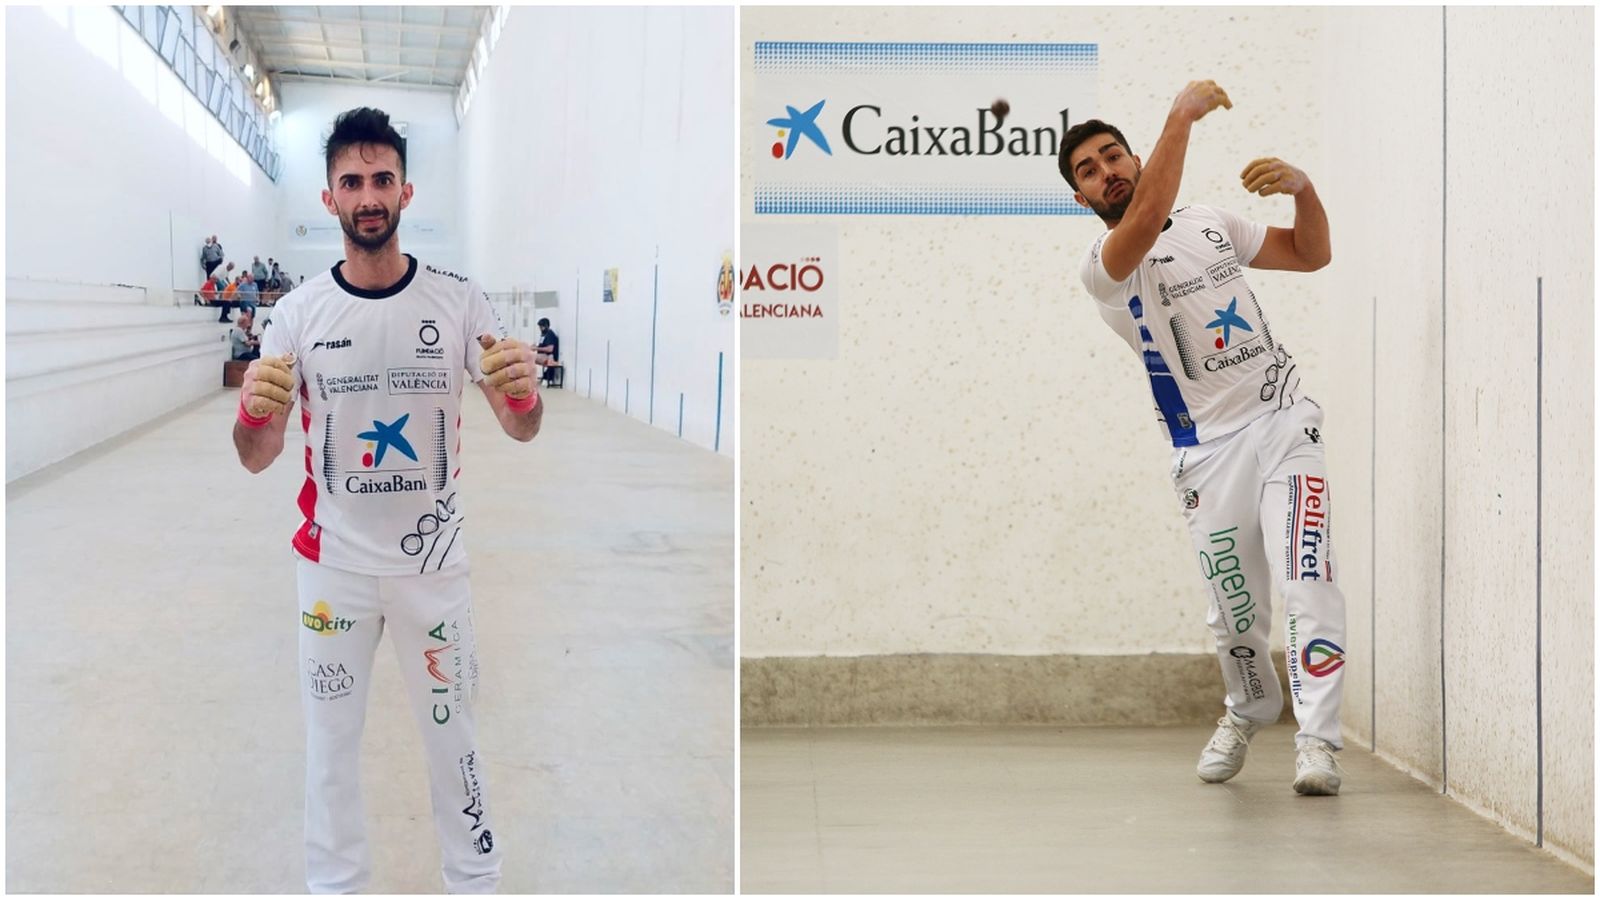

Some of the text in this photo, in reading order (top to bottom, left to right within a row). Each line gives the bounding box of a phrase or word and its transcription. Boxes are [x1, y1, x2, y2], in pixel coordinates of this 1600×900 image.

[326, 337, 352, 350] rasán
[326, 374, 379, 386] GENERALITAT
[392, 377, 447, 389] VALÈNCIA
[328, 383, 379, 394] VALENCIANA
[1301, 474, 1326, 581] Delifret
[424, 620, 454, 725] CIMA
